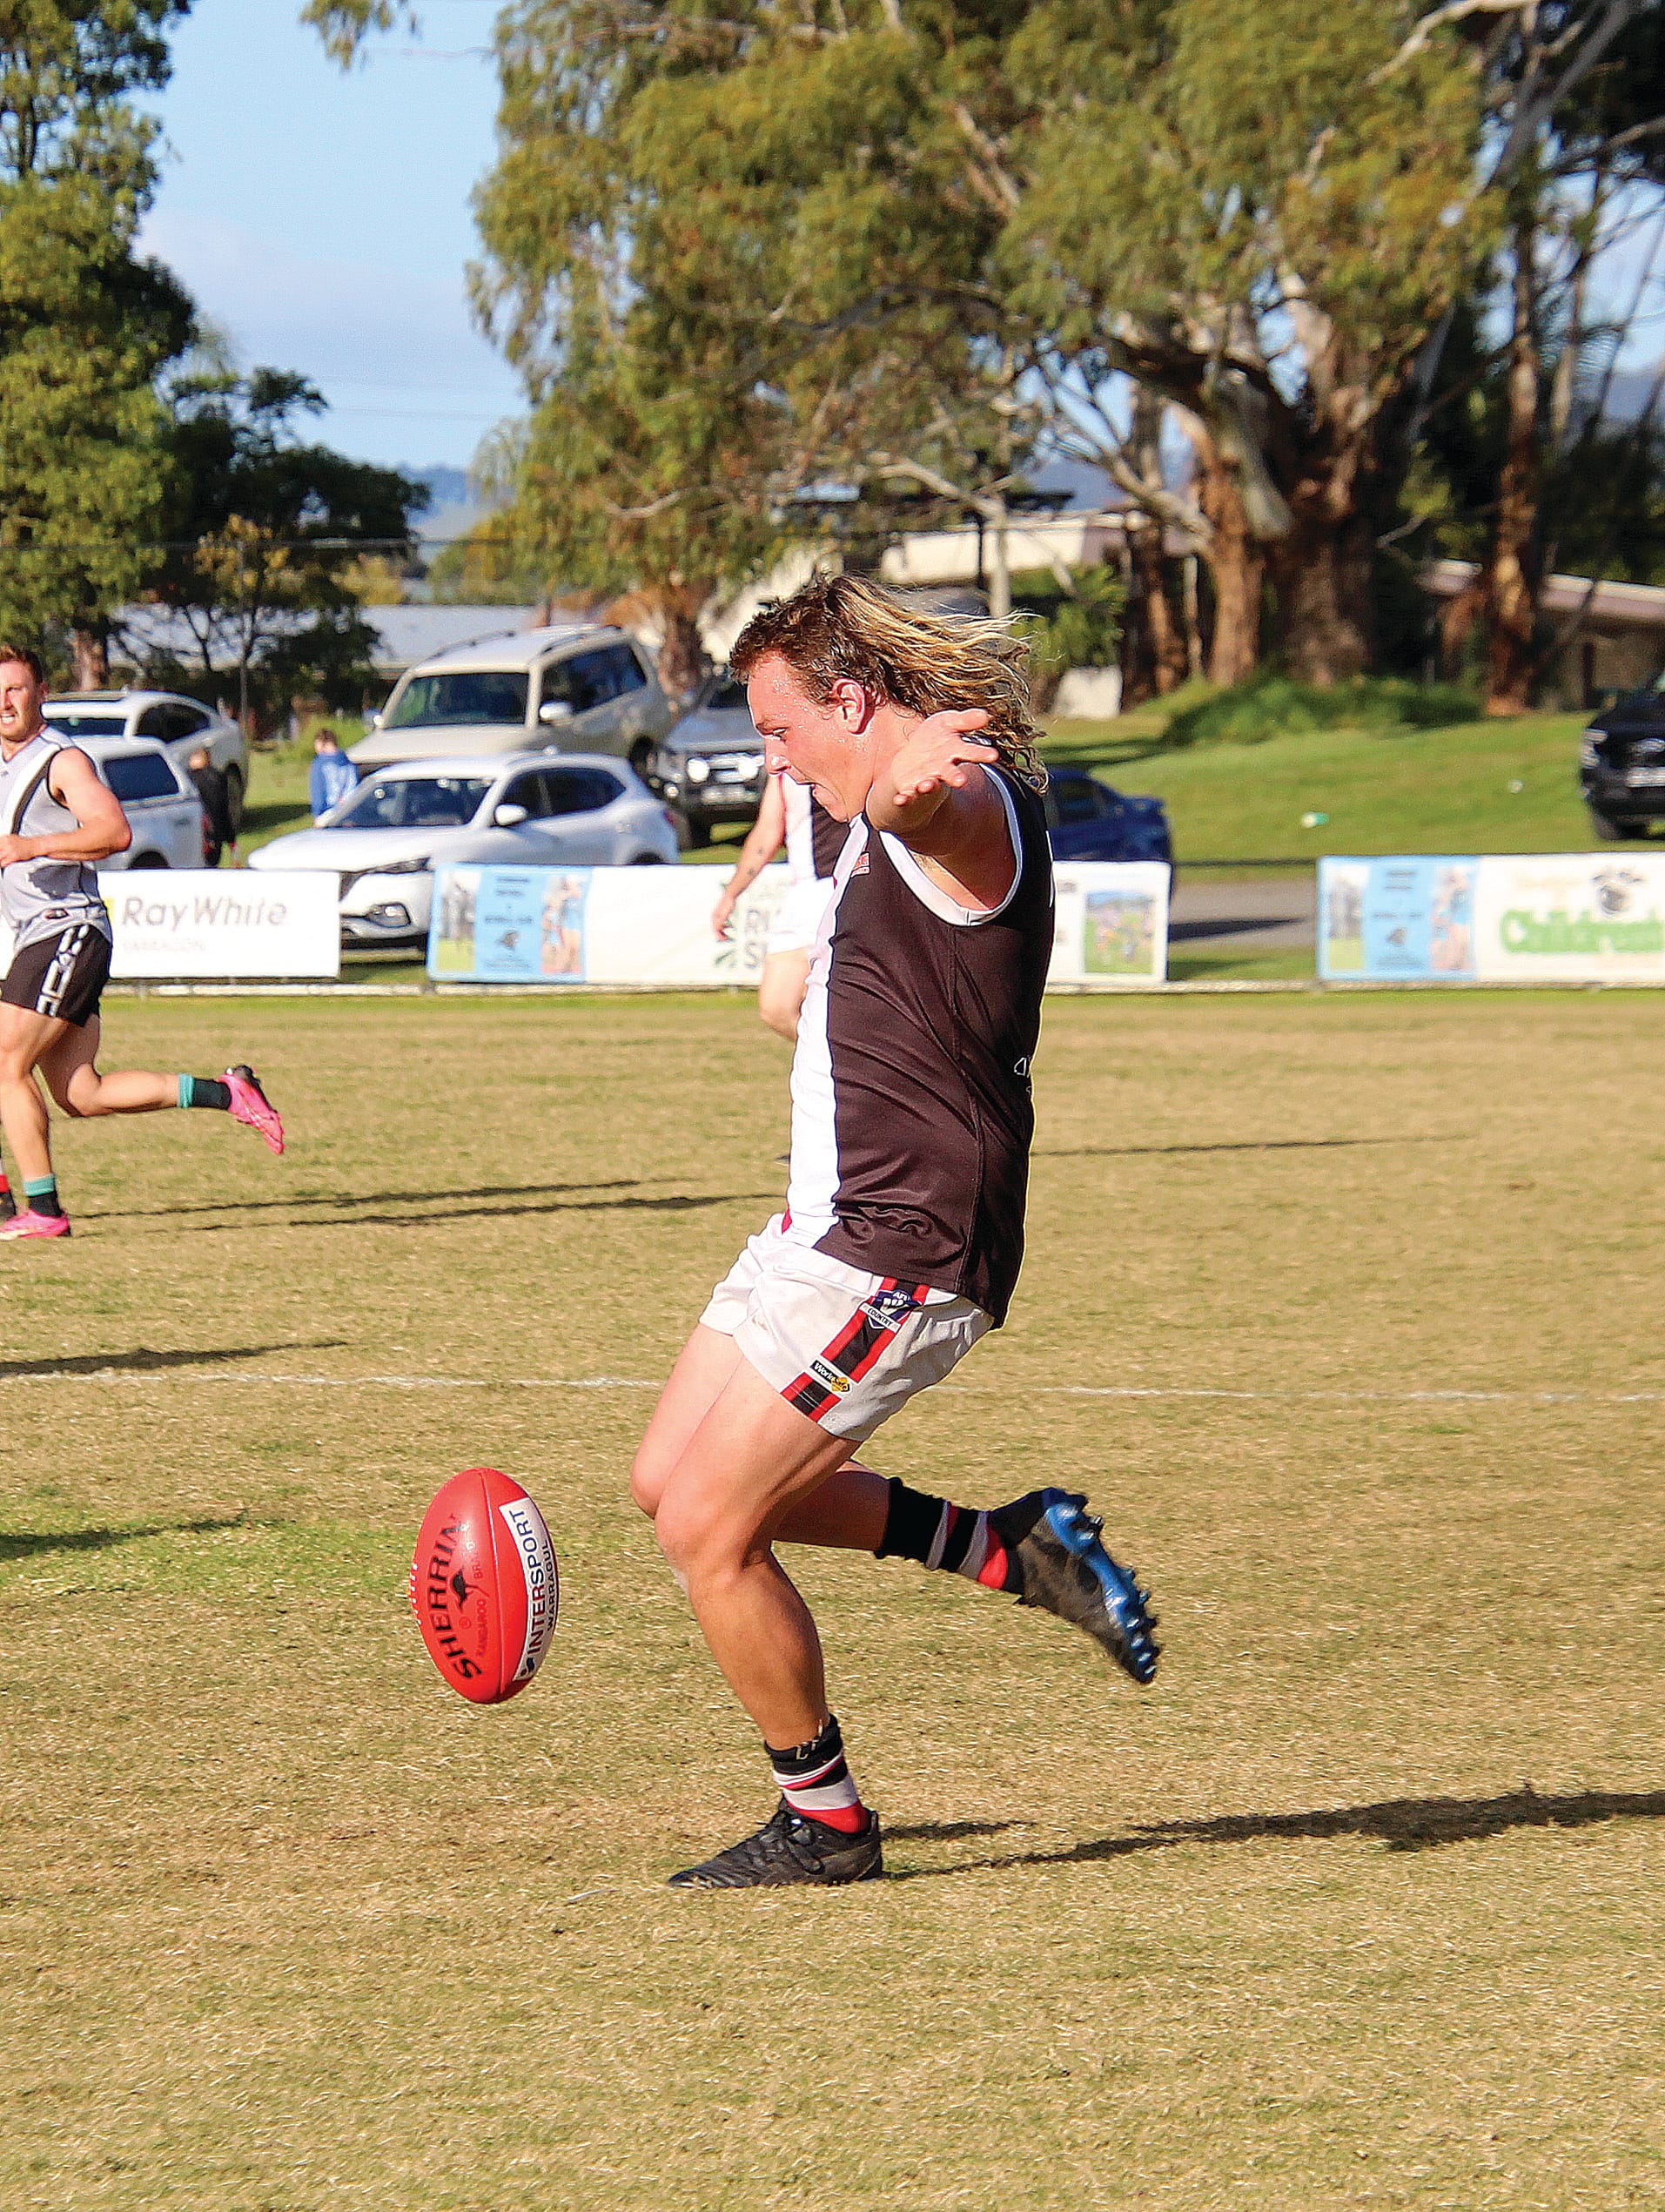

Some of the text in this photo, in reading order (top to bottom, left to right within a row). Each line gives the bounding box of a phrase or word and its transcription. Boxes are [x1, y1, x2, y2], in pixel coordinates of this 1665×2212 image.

[867, 1308, 893, 1327] COUNTRY
[508, 1509, 547, 1655] INTERSPORT
[541, 1538, 555, 1632] WARRAGUL
